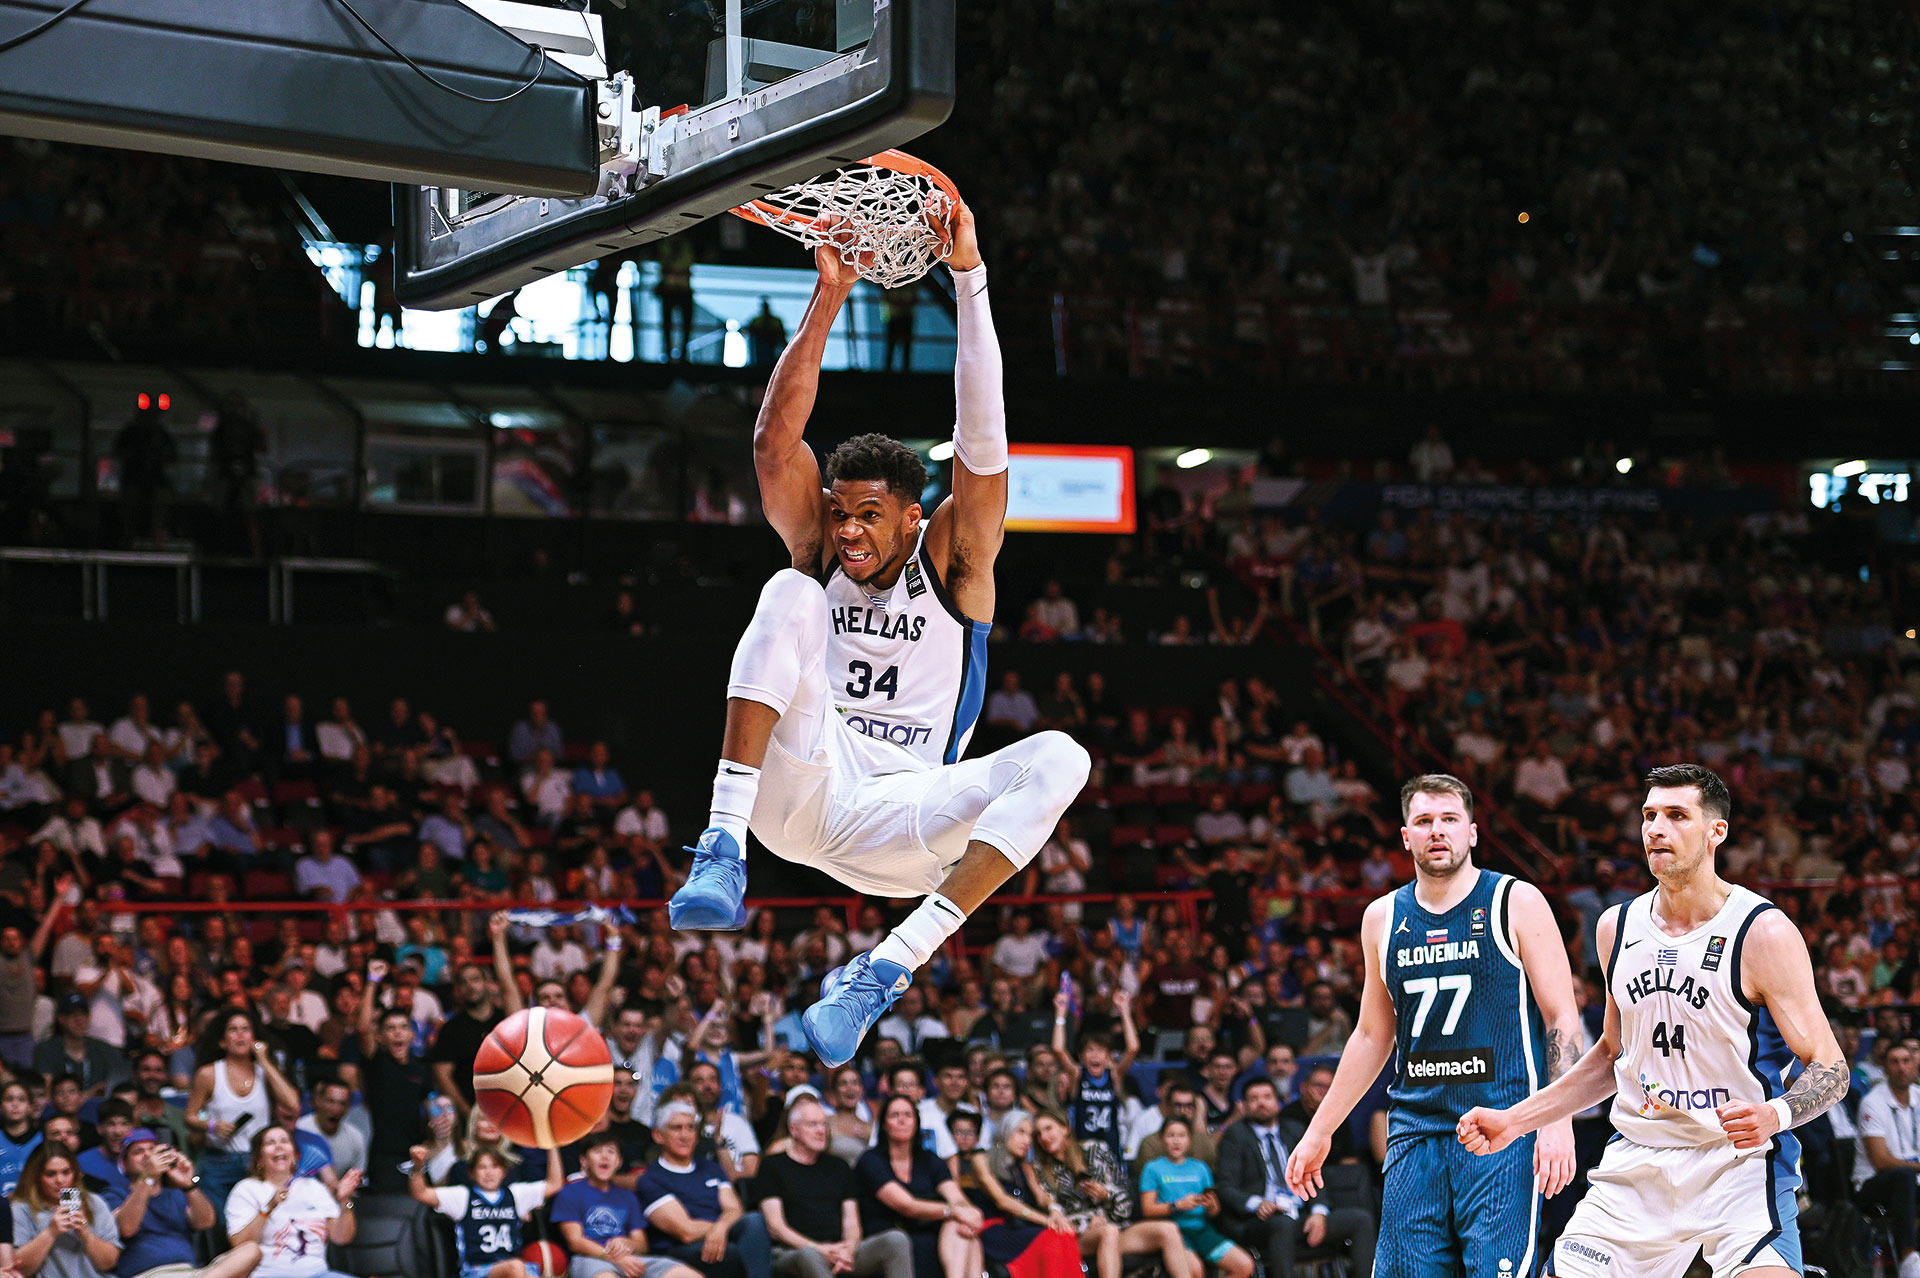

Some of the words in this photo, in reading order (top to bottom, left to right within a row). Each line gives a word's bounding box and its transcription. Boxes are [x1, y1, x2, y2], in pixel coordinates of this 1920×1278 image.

[831, 606, 926, 642] HELLAS
[846, 660, 899, 701] 34
[1397, 939, 1480, 968] SLOVENIJA
[1402, 974, 1472, 1038] 77
[1625, 967, 1710, 1010] HELLAS
[1652, 1021, 1686, 1059] 44
[1407, 1055, 1486, 1078] telemach
[1084, 1105, 1112, 1132] 34
[478, 1224, 513, 1253] 34
